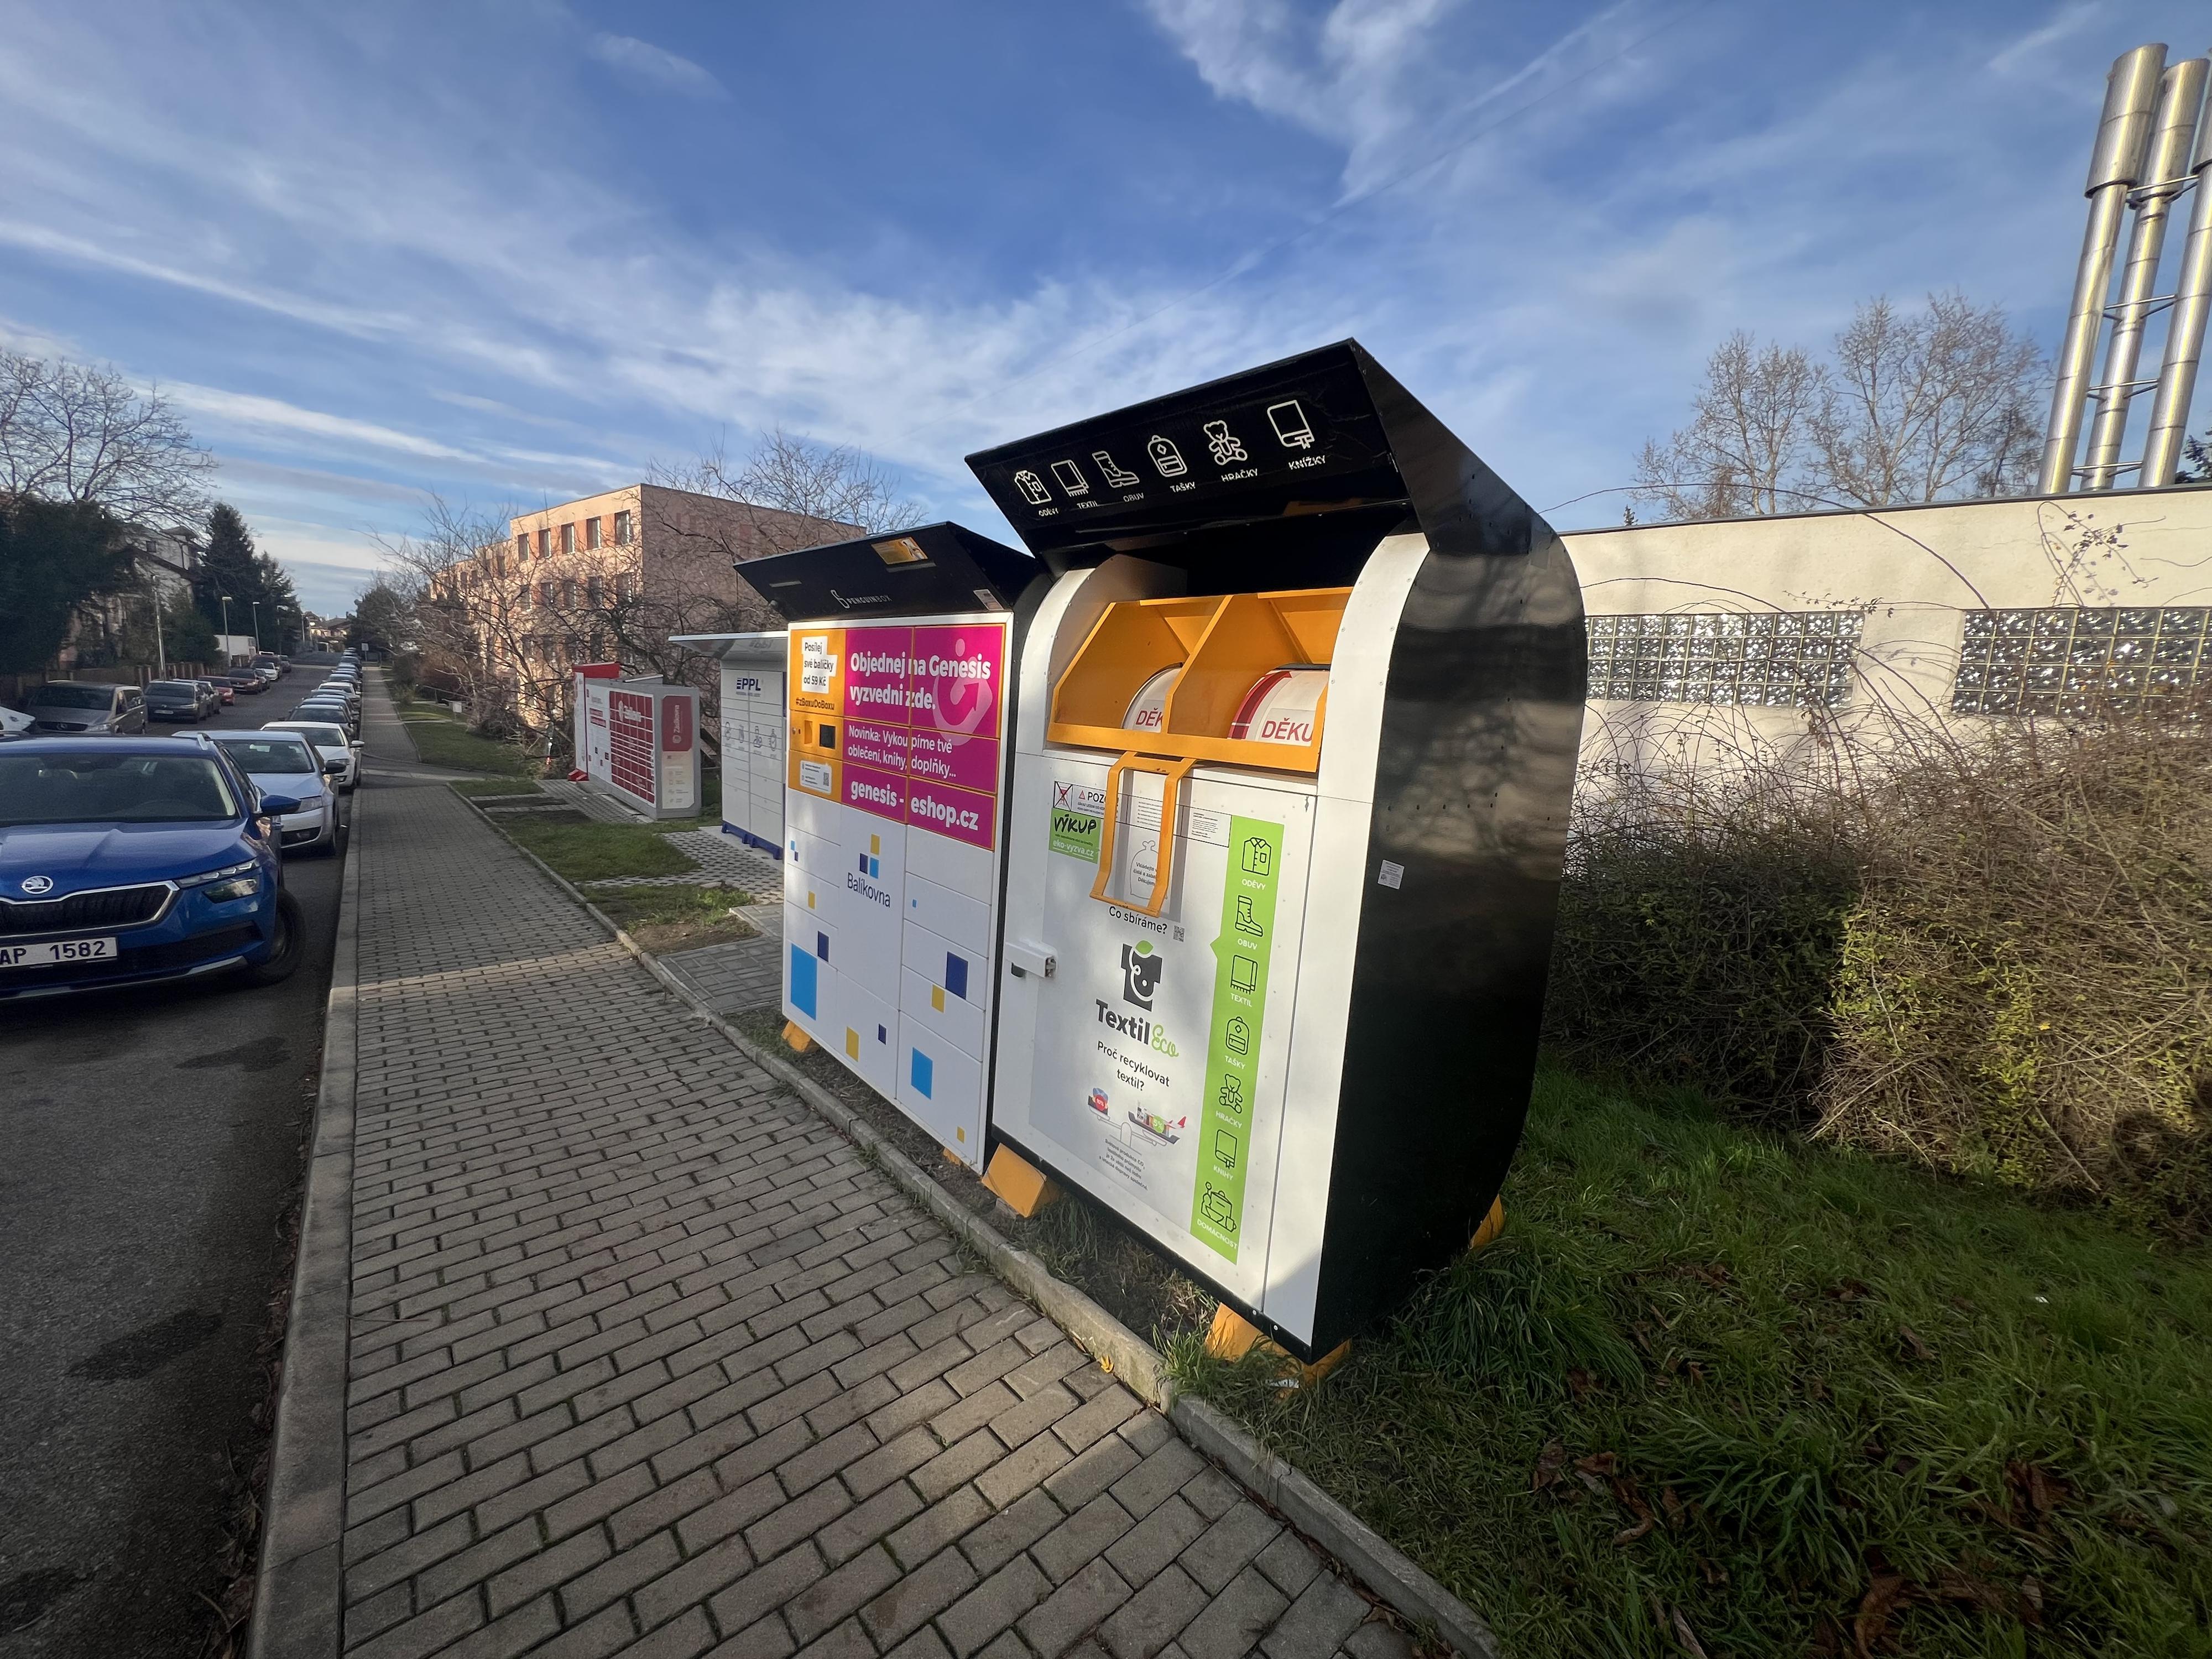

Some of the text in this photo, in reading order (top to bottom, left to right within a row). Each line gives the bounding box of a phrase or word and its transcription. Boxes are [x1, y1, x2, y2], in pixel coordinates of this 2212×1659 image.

[1288, 455, 1326, 469] KNÍŽKY
[1221, 468, 1258, 482] HRAČKY
[1170, 482, 1196, 493] TAŠKY
[1123, 493, 1144, 502] OBUV
[805, 642, 822, 654] Posílej
[804, 658, 813, 668] své
[851, 651, 991, 680] Objednej na Genesis
[742, 678, 761, 691] PPL
[804, 675, 826, 686] od 59 Kč
[795, 697, 835, 711] #zBoxuDoBoxu
[850, 684, 936, 709] vyzvedni zde.
[849, 725, 952, 753] Novinka: Vykoupíme tvé
[848, 744, 956, 779] oblečení, knihy, doplňky...
[851, 780, 898, 807] genesis
[911, 795, 979, 831] eshop.cz
[1054, 813, 1097, 834] VÝKUP
[1052, 839, 1093, 857] eko-vyzva.cz
[847, 872, 891, 908] Balíkovna
[1241, 878, 1266, 890] ODĚVY
[1109, 906, 1167, 935] Co sbíráme?
[50, 940, 106, 960] 1582
[1238, 938, 1258, 950] OBUV
[1230, 993, 1253, 1008] TEXTIL
[1098, 1040, 1170, 1087] Proč recyklovat
[1224, 1055, 1246, 1070] TAŠKY
[1117, 1068, 1145, 1091] textil?
[1215, 1110, 1243, 1129] HRAČKY
[1213, 1164, 1234, 1181] KNIHY
